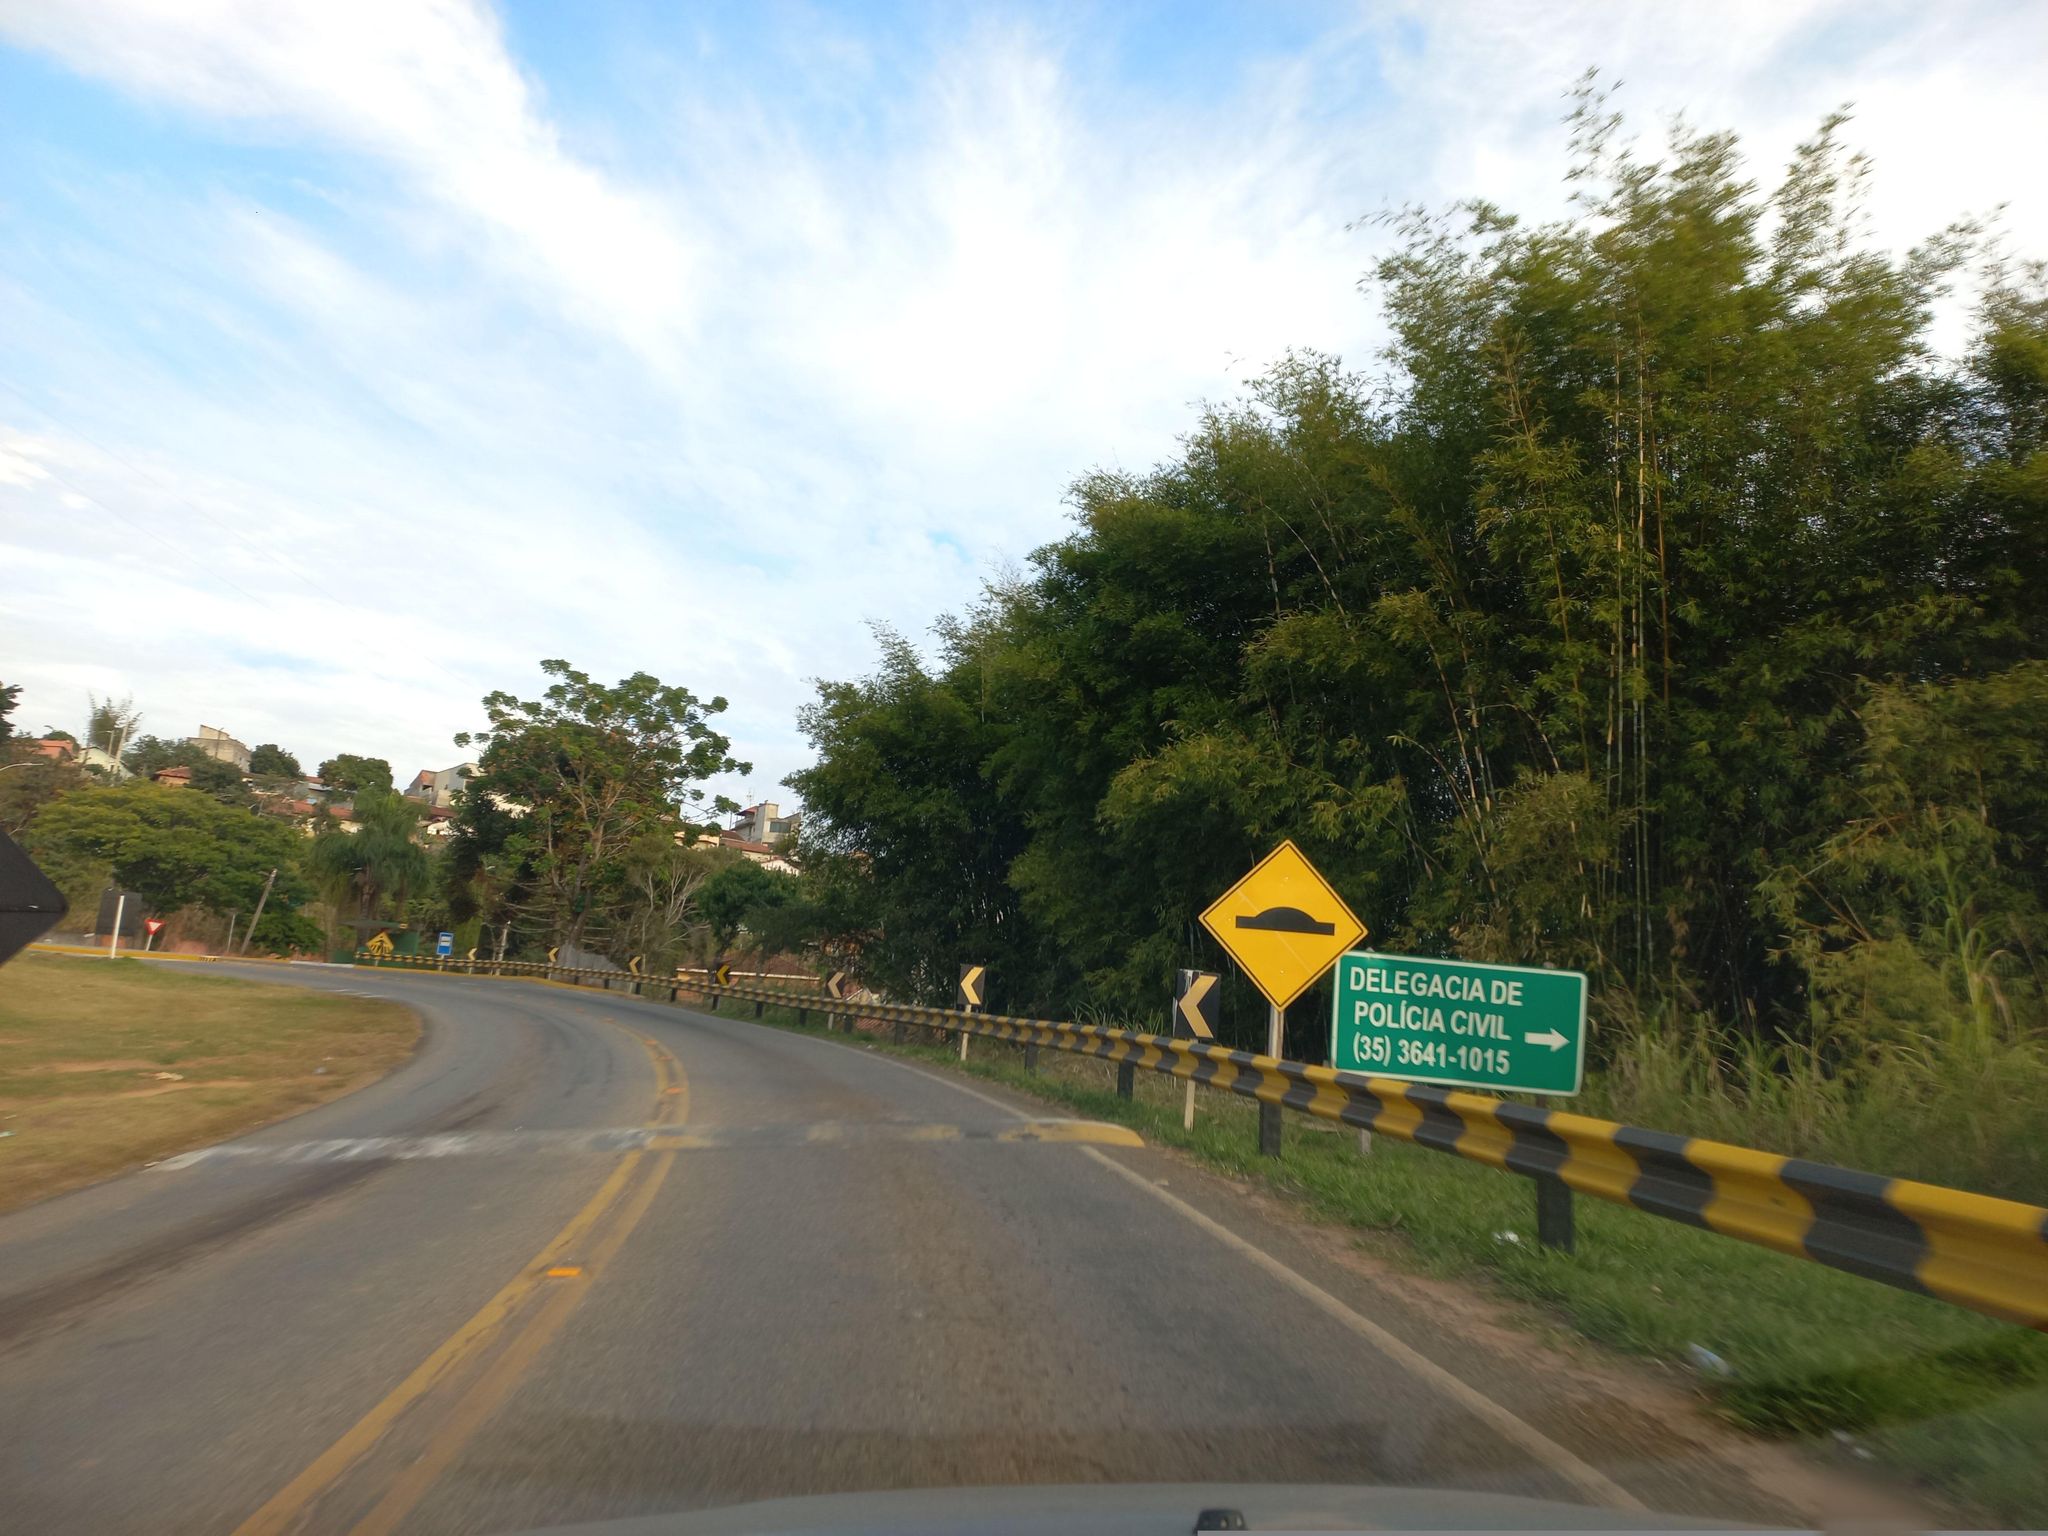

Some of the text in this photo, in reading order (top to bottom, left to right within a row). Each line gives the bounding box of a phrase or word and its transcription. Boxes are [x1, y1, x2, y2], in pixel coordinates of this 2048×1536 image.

[1350, 966, 1524, 1006] DELEGACIA DE
[1354, 1000, 1512, 1041] POLÍCIA CIVIL
[1353, 1032, 1511, 1075] (35) 3641-1015
